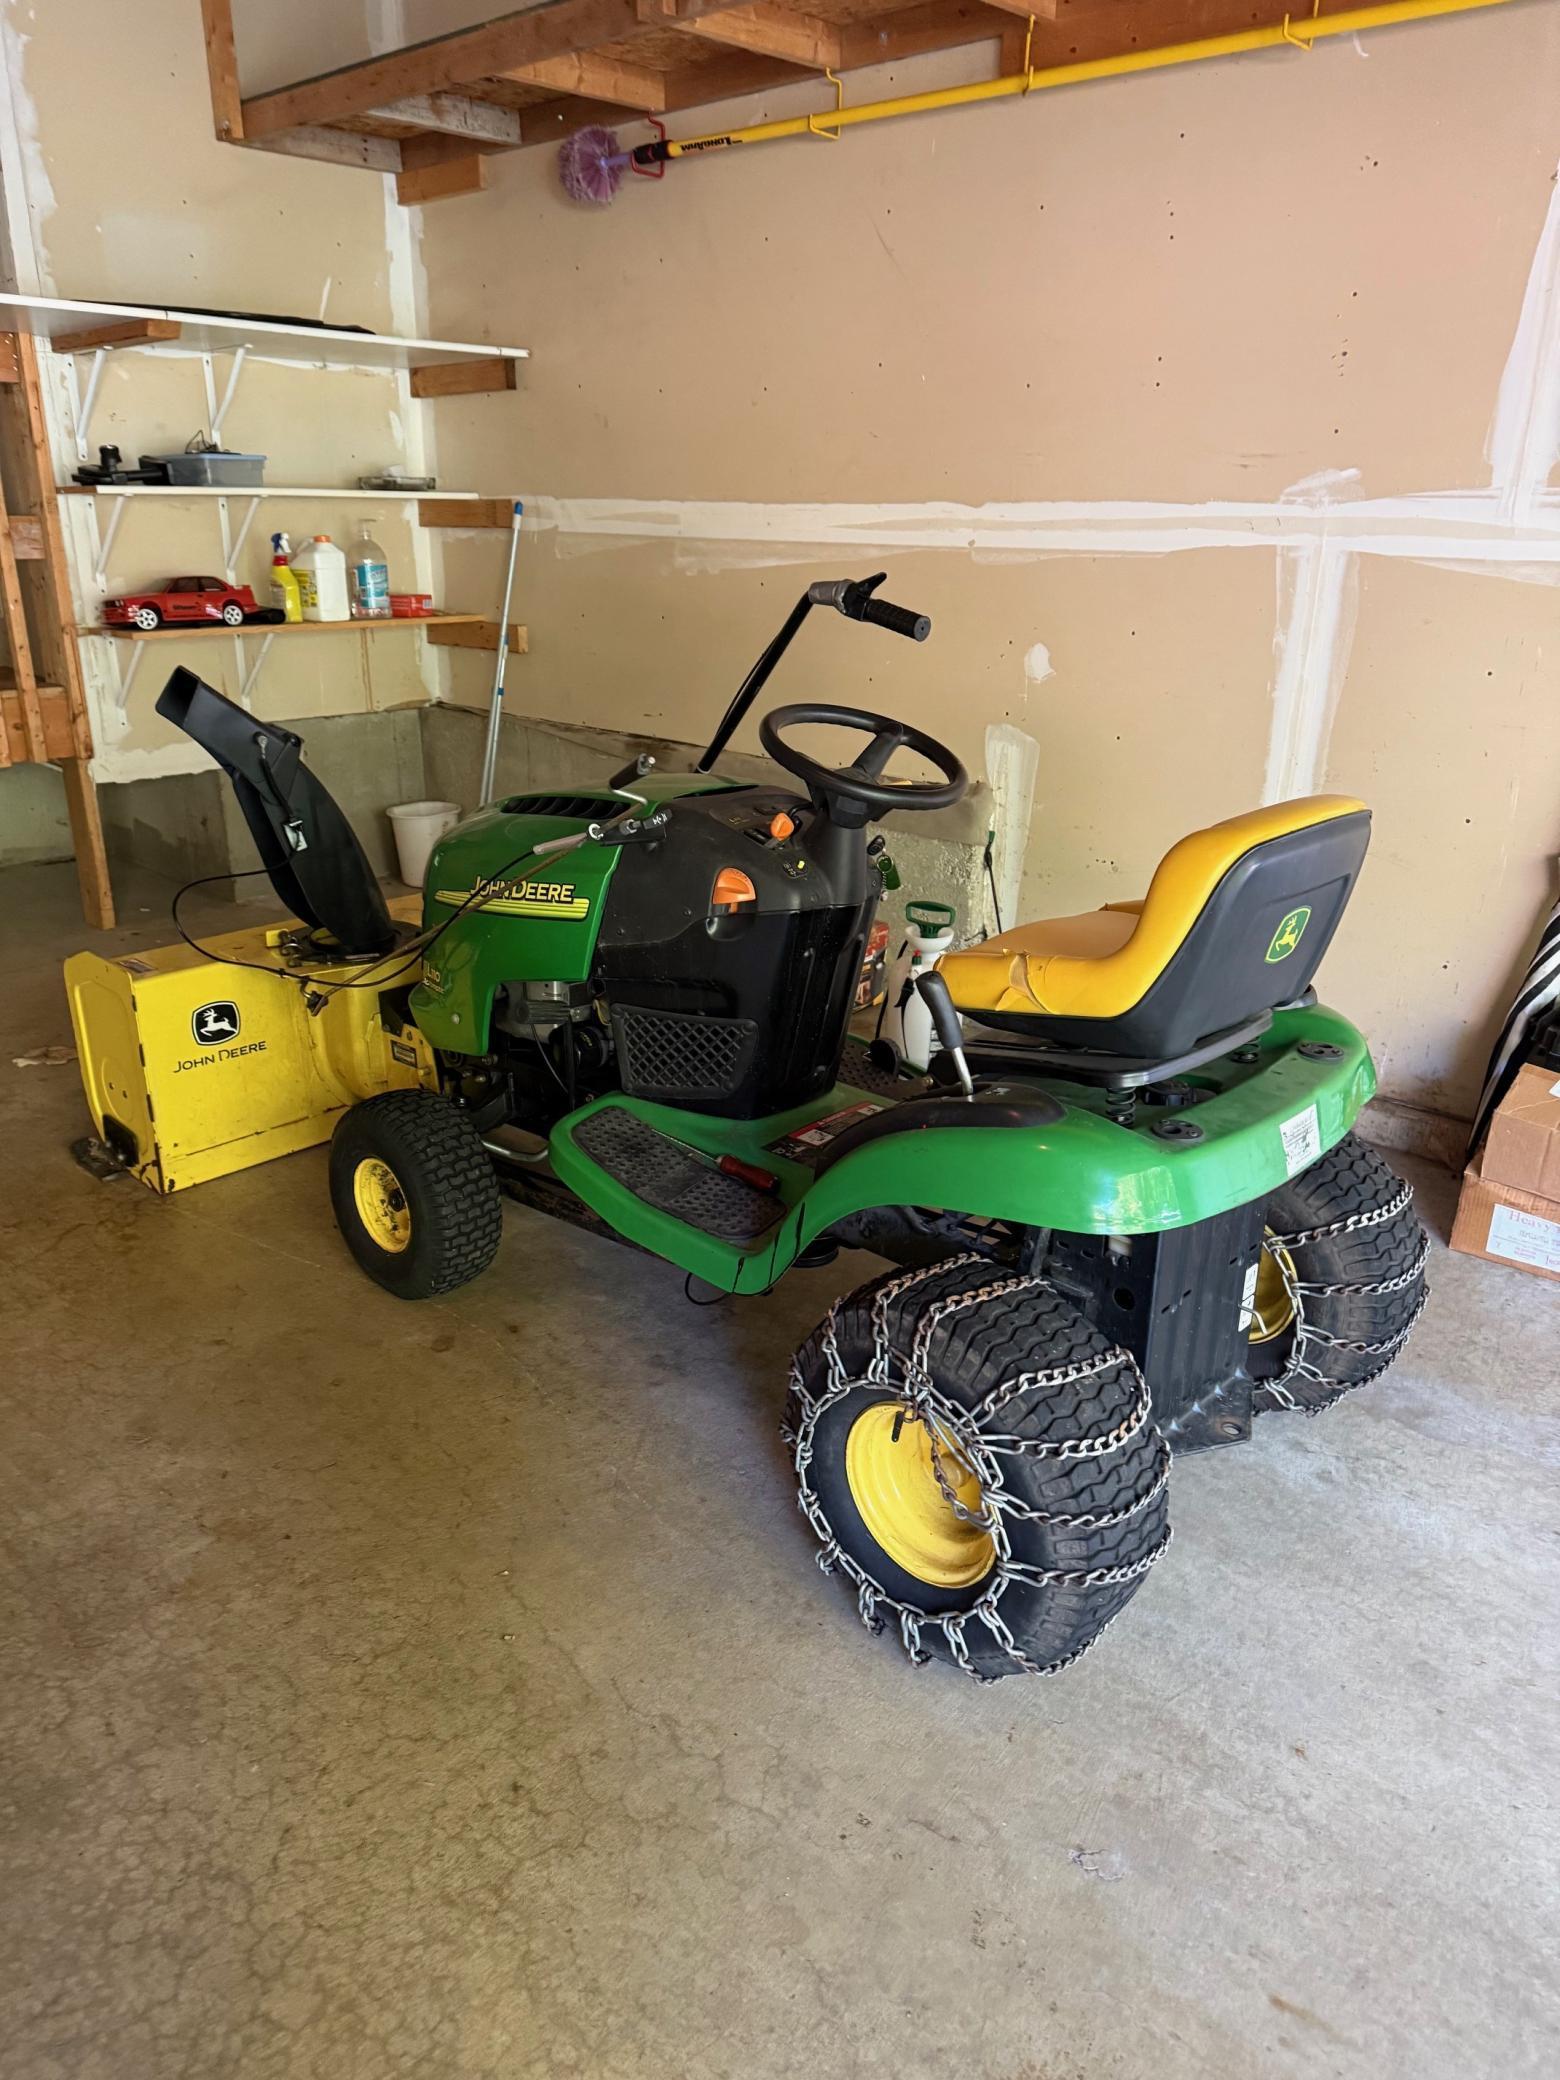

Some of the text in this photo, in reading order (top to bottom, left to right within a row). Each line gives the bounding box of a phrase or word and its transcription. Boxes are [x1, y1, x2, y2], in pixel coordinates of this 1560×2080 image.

[511, 880, 575, 902] DEERE
[173, 1041, 267, 1073] JOHN DEERE
